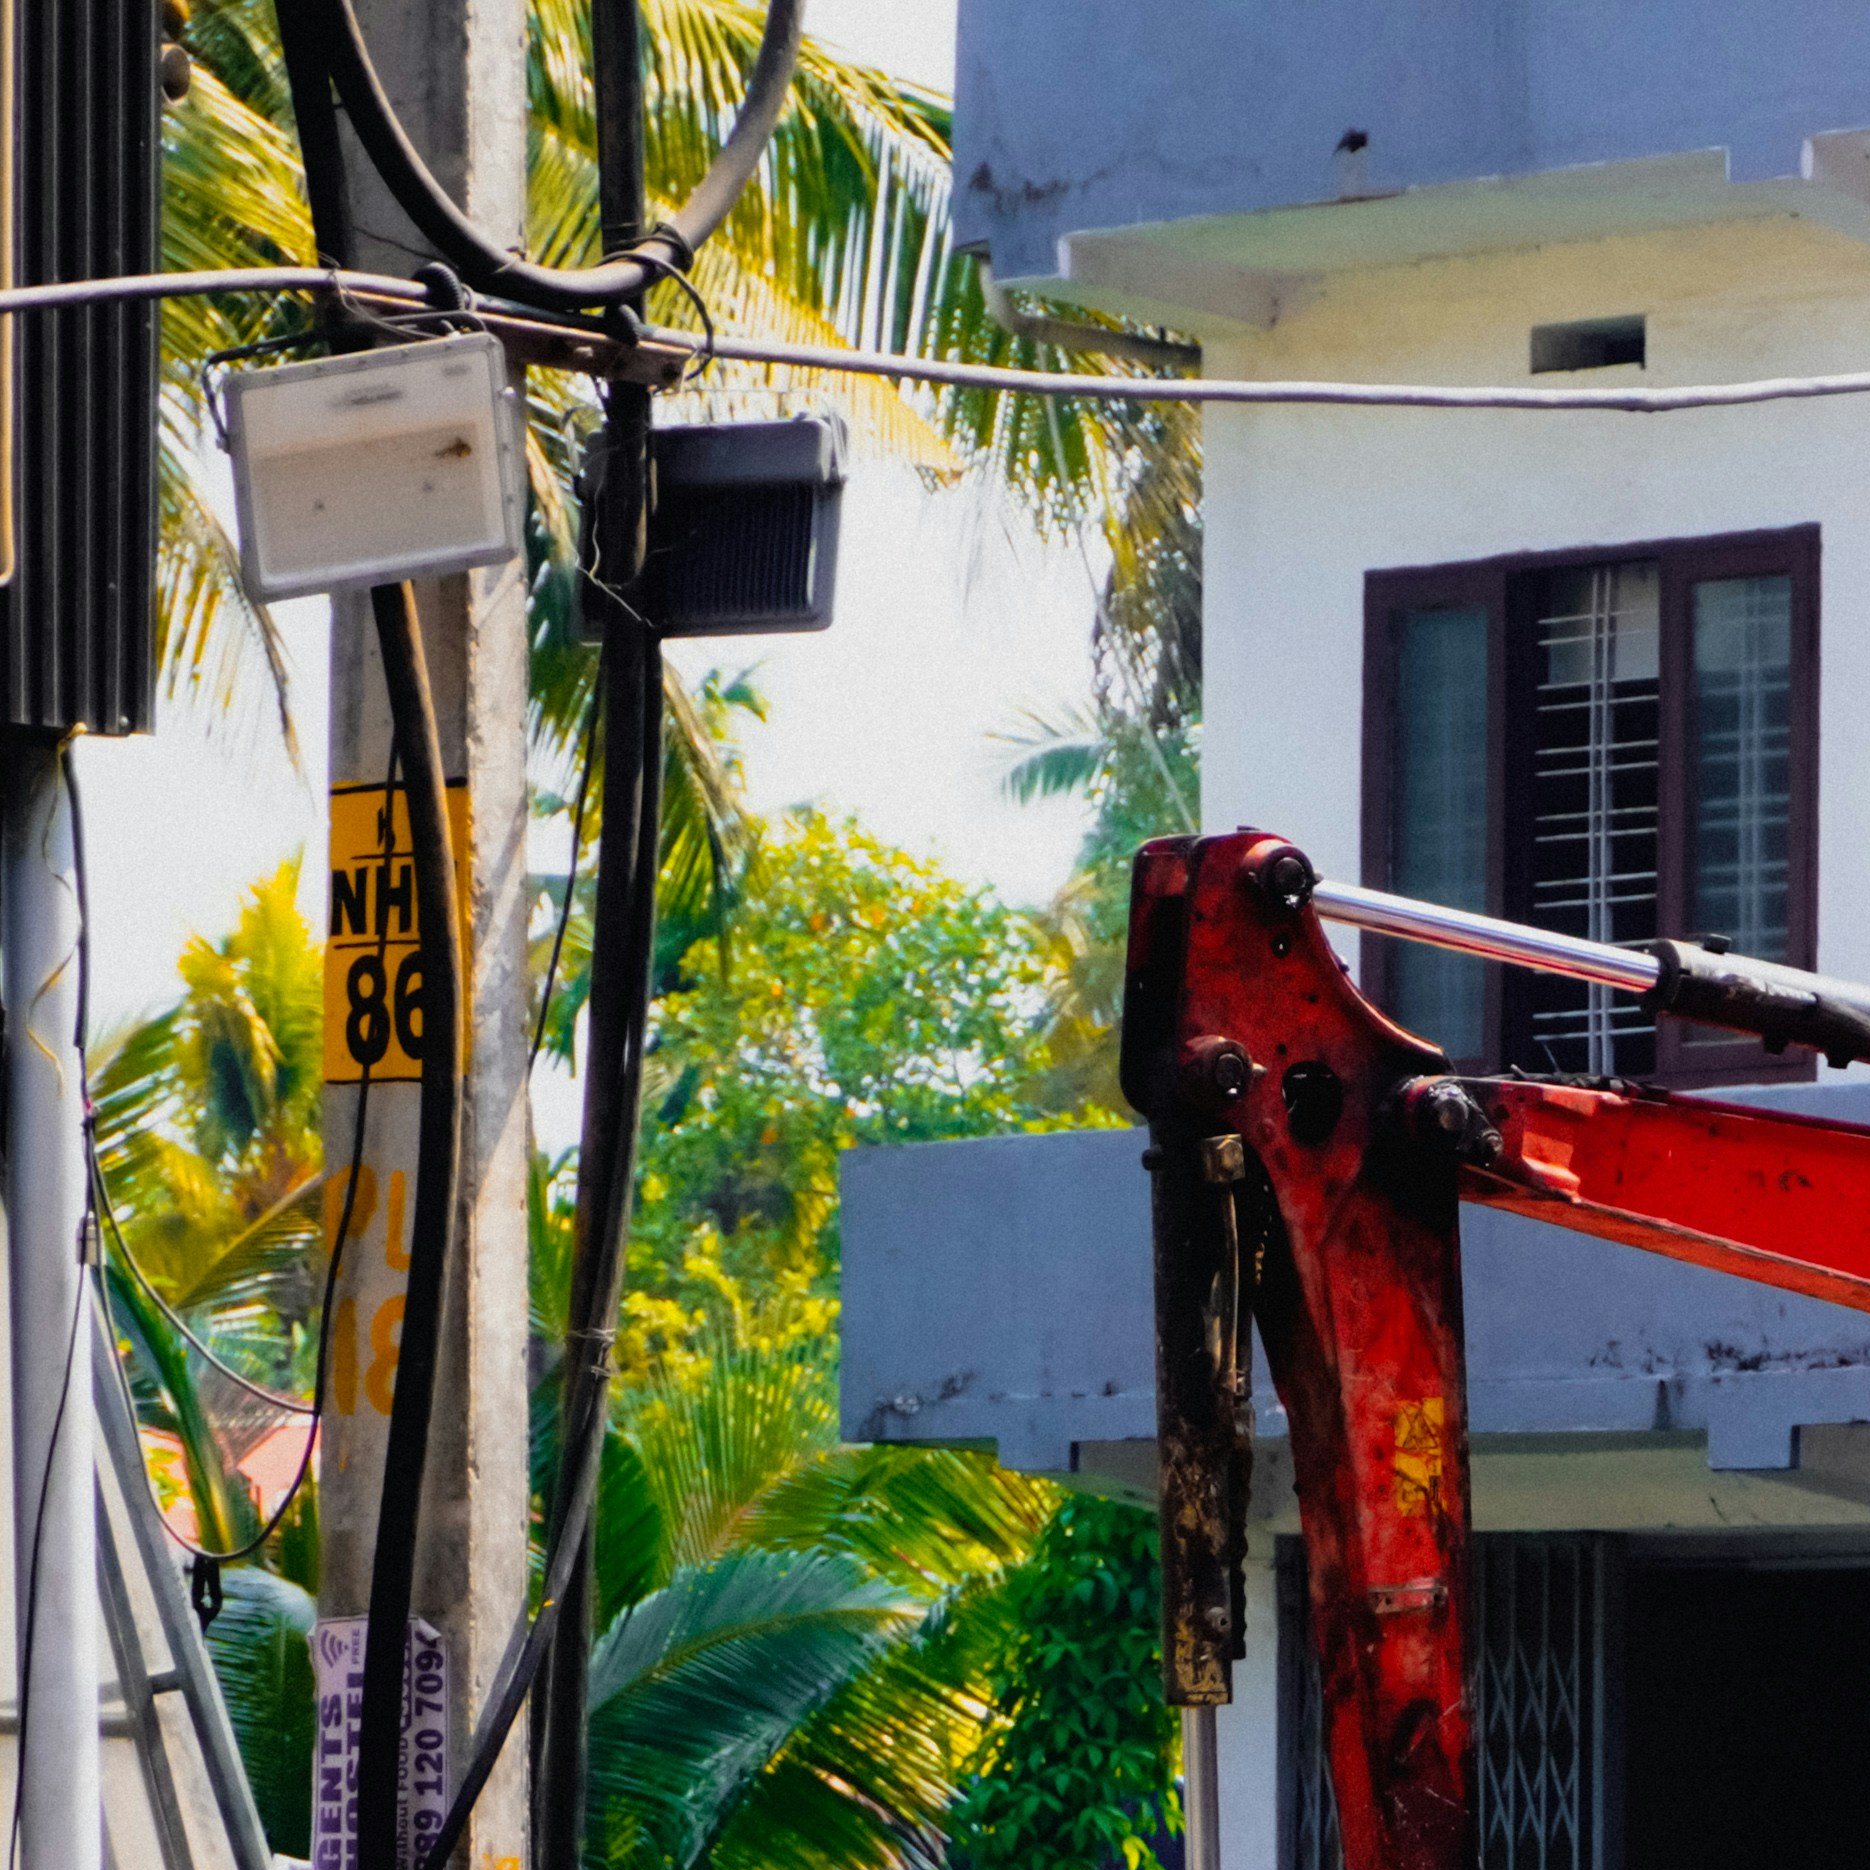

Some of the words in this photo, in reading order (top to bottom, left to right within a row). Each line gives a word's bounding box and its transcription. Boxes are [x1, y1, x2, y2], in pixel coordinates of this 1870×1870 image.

[331, 864, 412, 936] NH
[346, 950, 424, 1066] 86
[413, 1728, 444, 1796] 120
